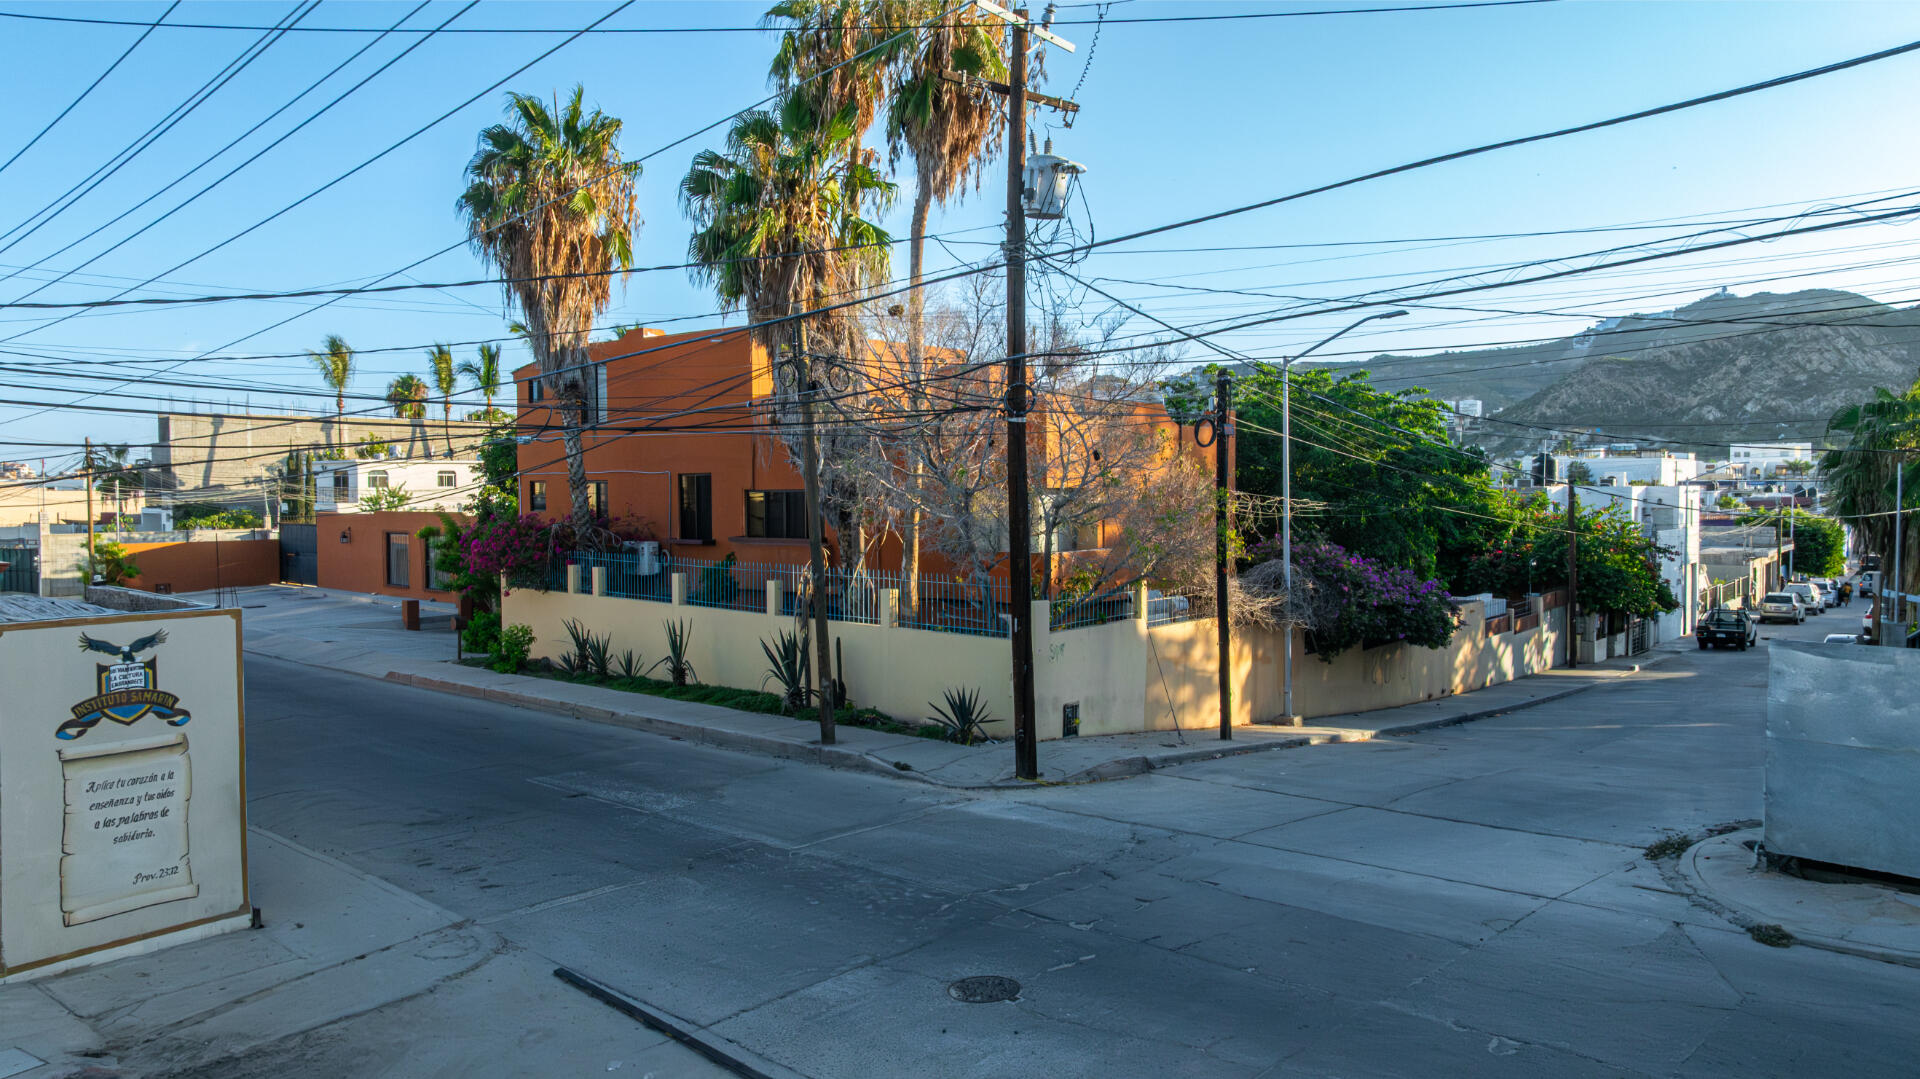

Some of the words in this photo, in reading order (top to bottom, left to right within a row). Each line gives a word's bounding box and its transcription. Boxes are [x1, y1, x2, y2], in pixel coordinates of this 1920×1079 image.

[74, 692, 128, 717] INSTITUTO
[130, 691, 176, 708] SAMARIN
[86, 780, 115, 793] Aplica
[116, 777, 126, 789] tu
[127, 772, 158, 787] corazón
[167, 769, 175, 780] la
[89, 796, 135, 811] enseñanza
[136, 794, 143, 806] y
[144, 791, 156, 802] tus
[94, 820, 101, 829] a
[103, 816, 116, 828] las
[116, 810, 159, 828] palabras
[160, 806, 170, 818] de
[132, 872, 159, 885] Prov.
